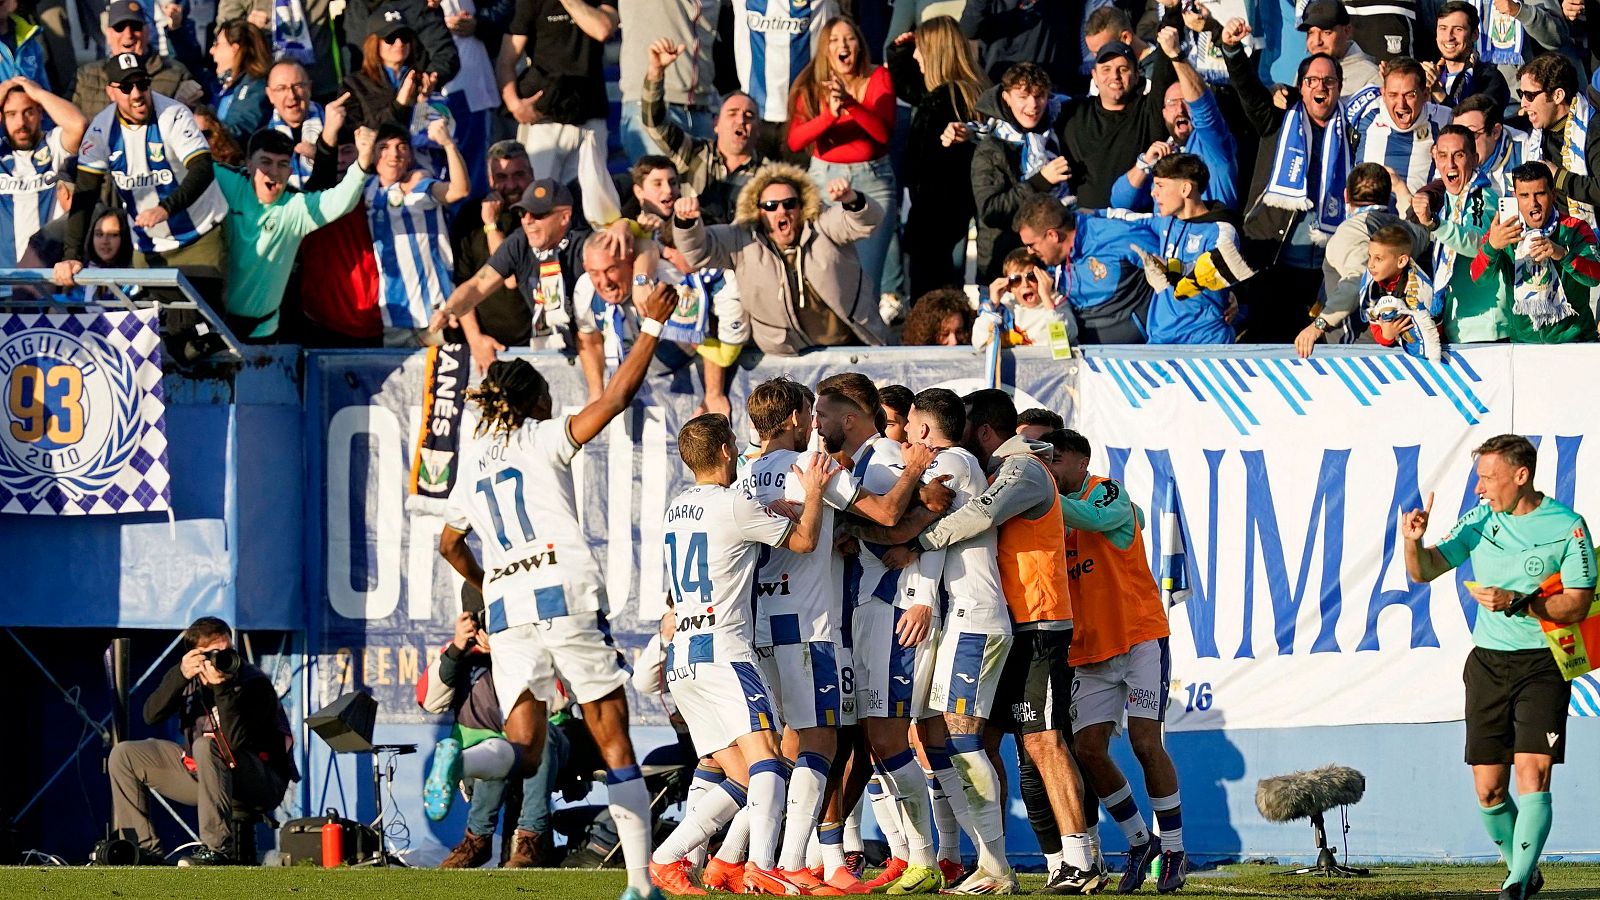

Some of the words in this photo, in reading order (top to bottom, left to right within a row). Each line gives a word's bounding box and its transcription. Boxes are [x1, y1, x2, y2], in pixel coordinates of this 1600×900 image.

[9, 364, 85, 445] 93
[25, 447, 80, 469] 2010
[476, 466, 536, 551] 17
[668, 504, 705, 523] DARKO
[489, 543, 558, 584] zowi
[664, 531, 714, 603] 14
[841, 667, 855, 695] 8
[1136, 699, 1158, 711] POKE
[1185, 682, 1213, 713] 16
